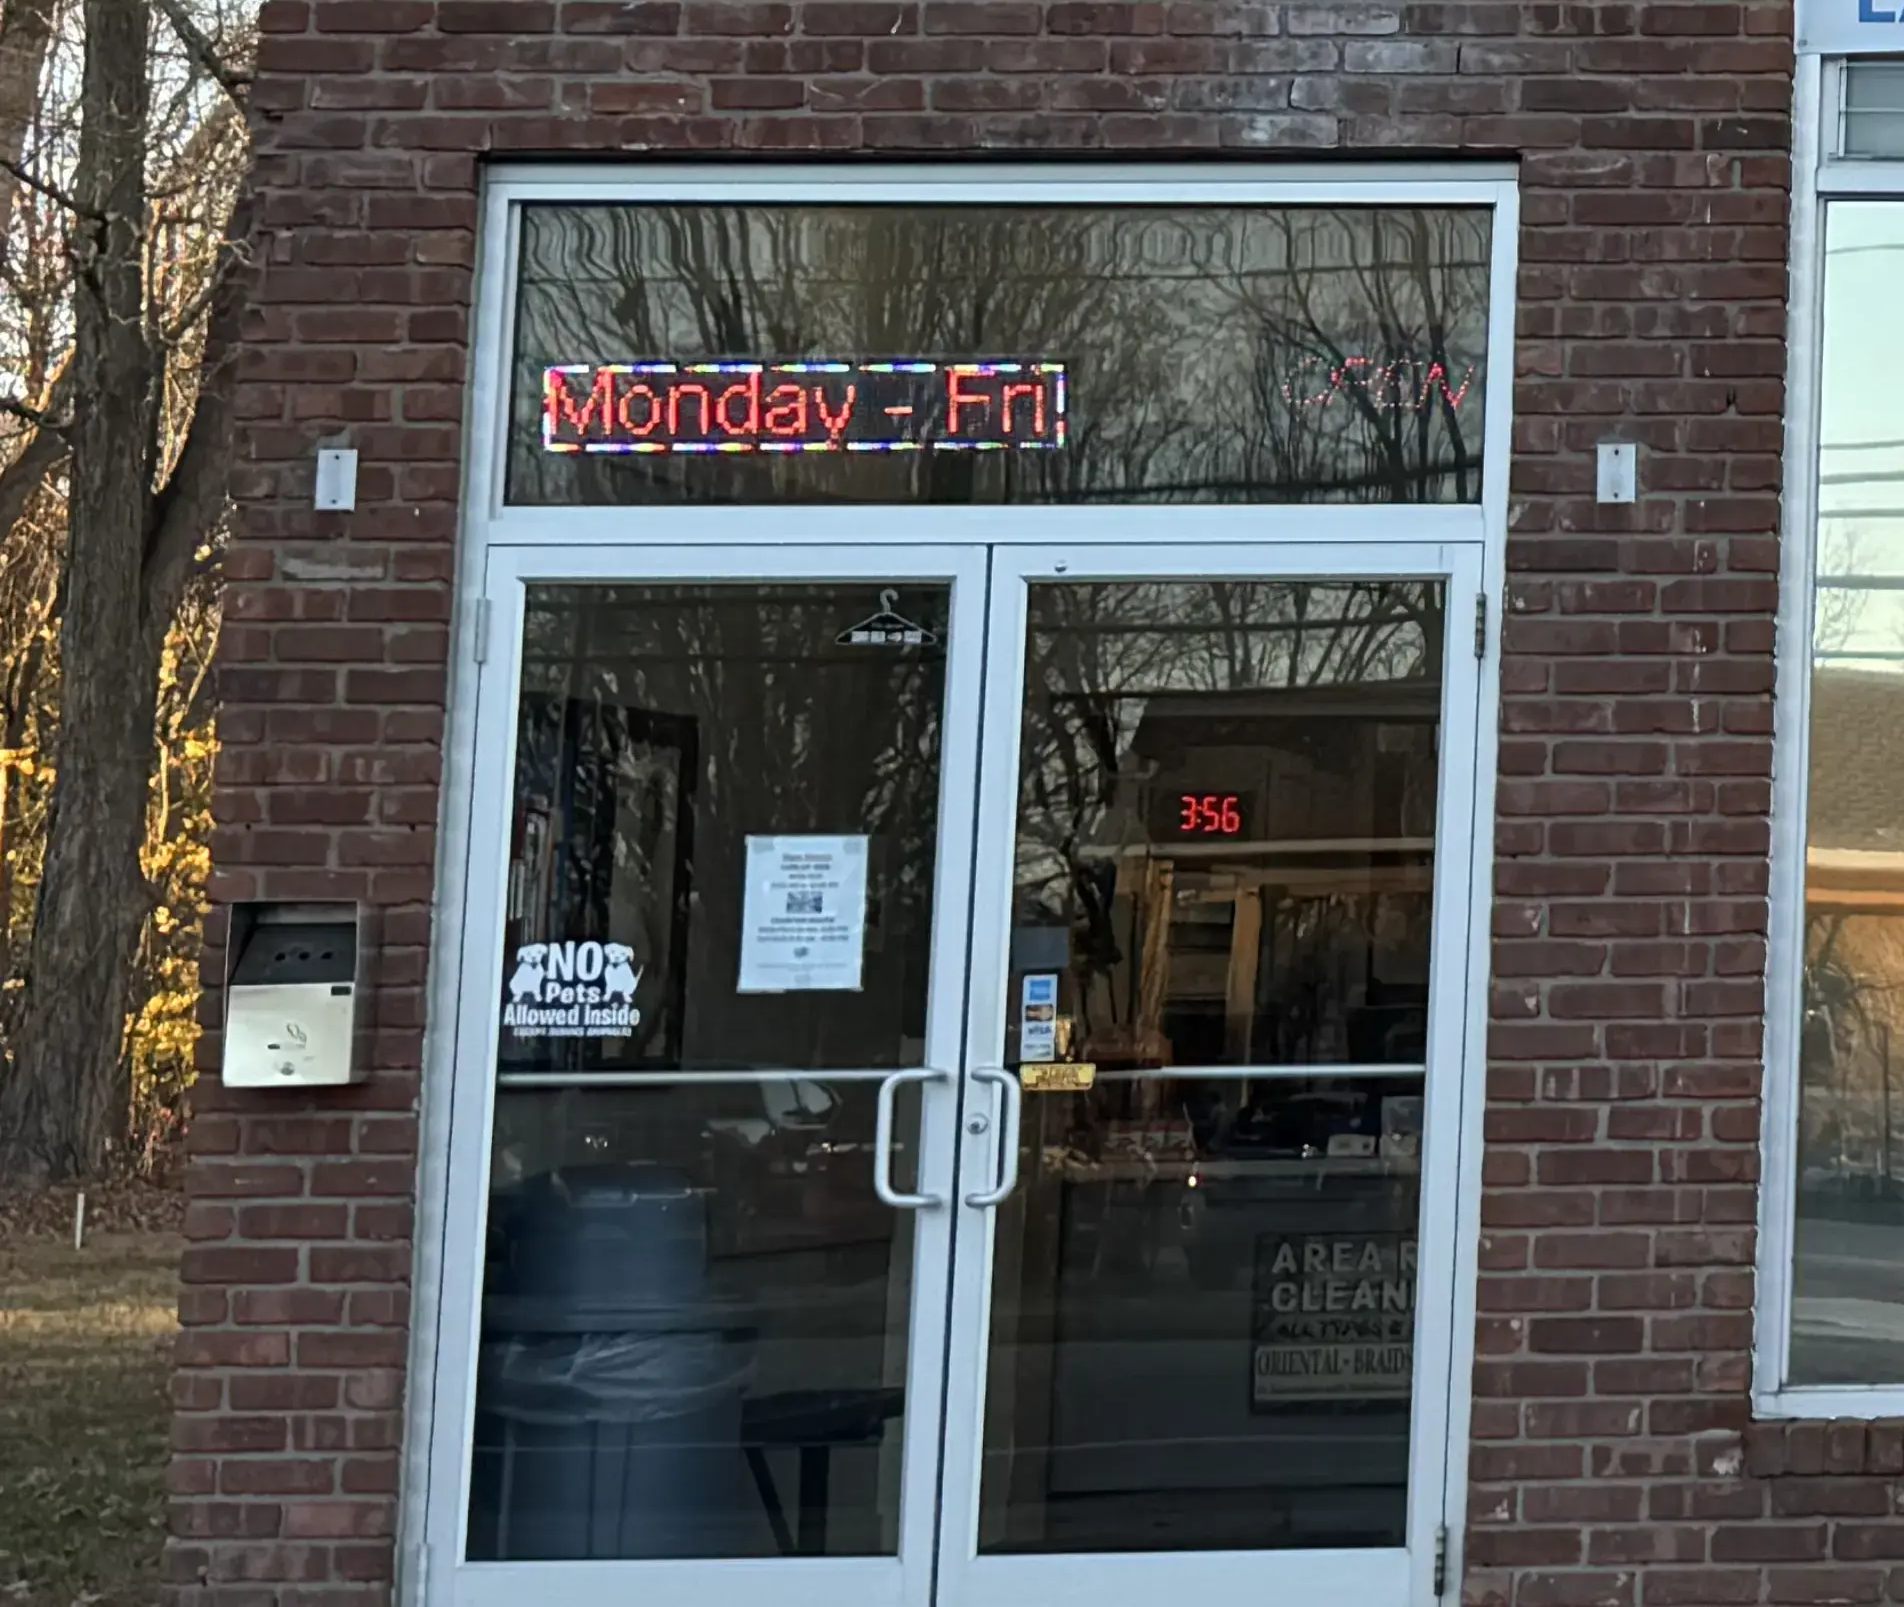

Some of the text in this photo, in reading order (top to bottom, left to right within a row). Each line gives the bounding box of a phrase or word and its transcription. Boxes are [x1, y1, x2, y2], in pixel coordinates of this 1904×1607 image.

[545, 367, 855, 449] Monday
[1180, 795, 1240, 833] 3:56
[546, 939, 604, 982] NO
[545, 981, 602, 1004] Pets
[503, 1003, 641, 1026] Allowed Inside
[1271, 1240, 1383, 1274] AREA
